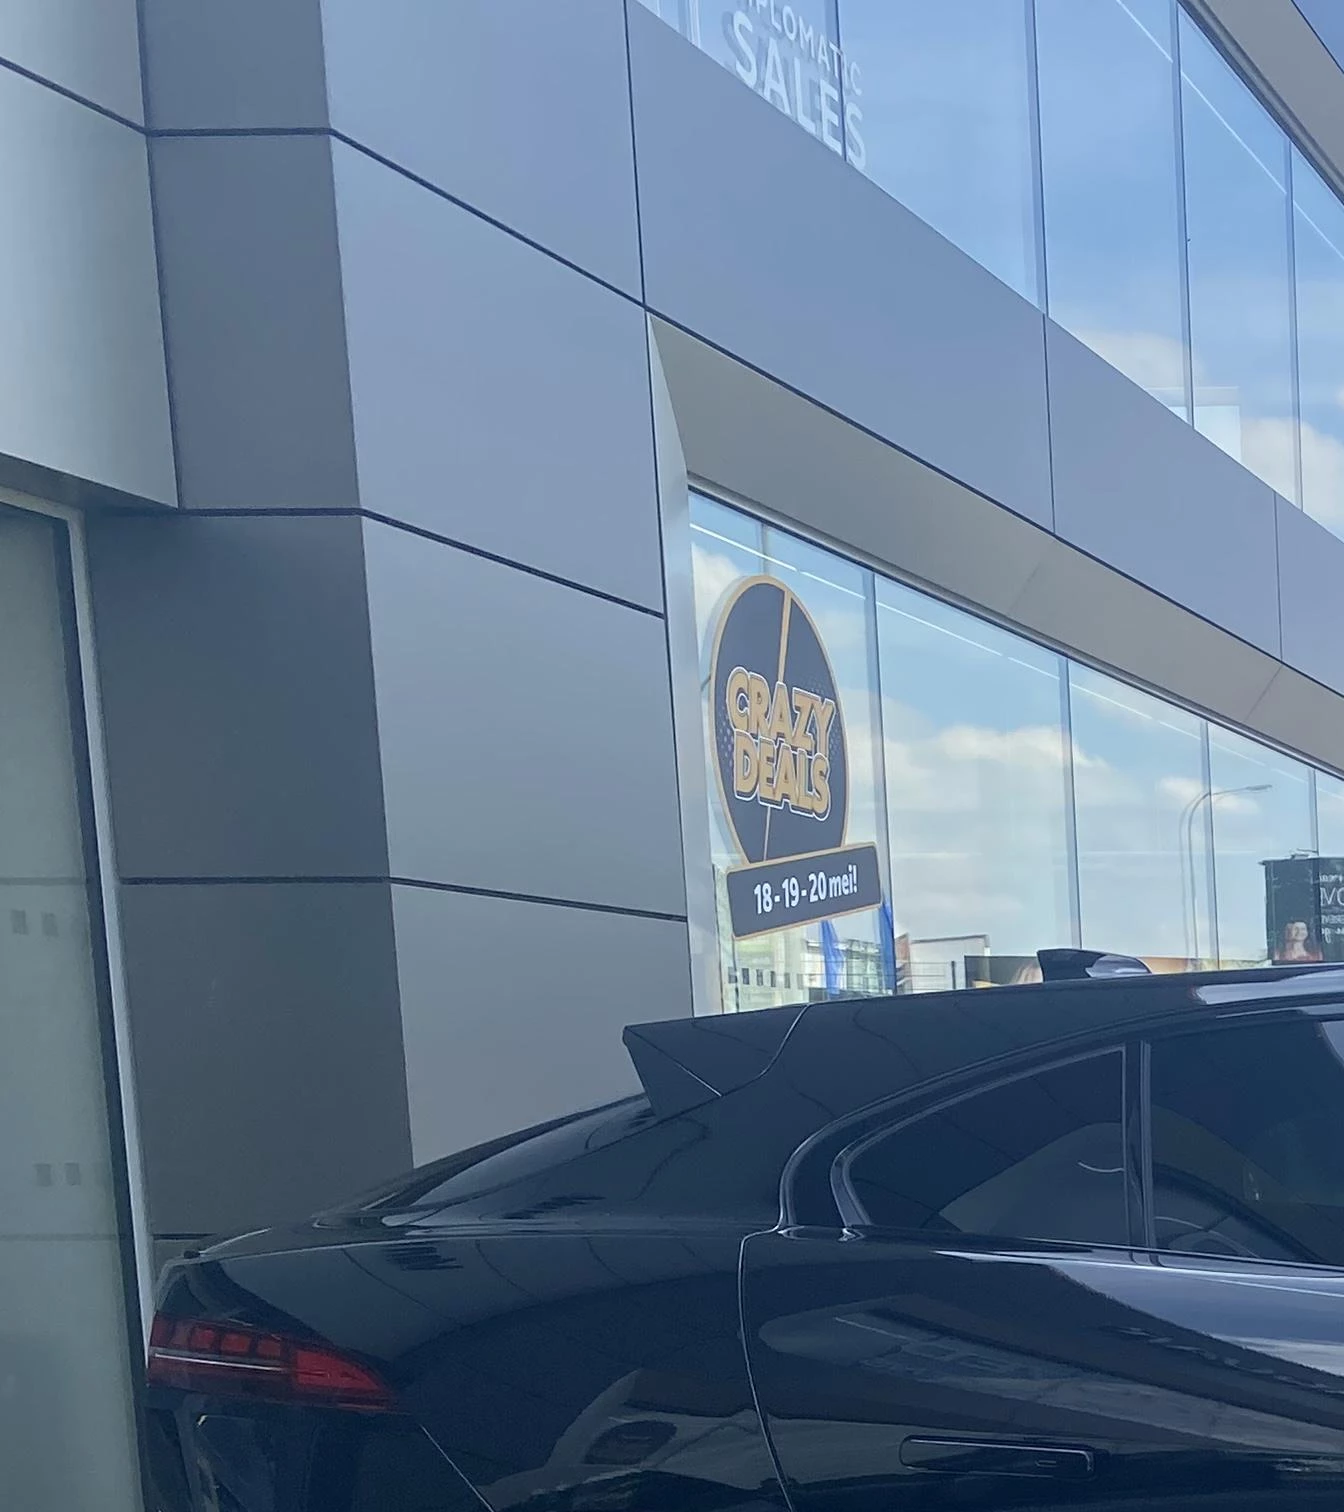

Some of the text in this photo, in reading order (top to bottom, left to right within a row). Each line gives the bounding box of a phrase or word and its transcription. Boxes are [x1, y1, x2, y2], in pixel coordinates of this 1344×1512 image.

[732, 10, 866, 169] SALES
[748, 0, 863, 96] LOMATIC
[726, 666, 836, 758] CRAZY
[733, 729, 832, 821] DEALS
[828, 863, 858, 898] mei!
